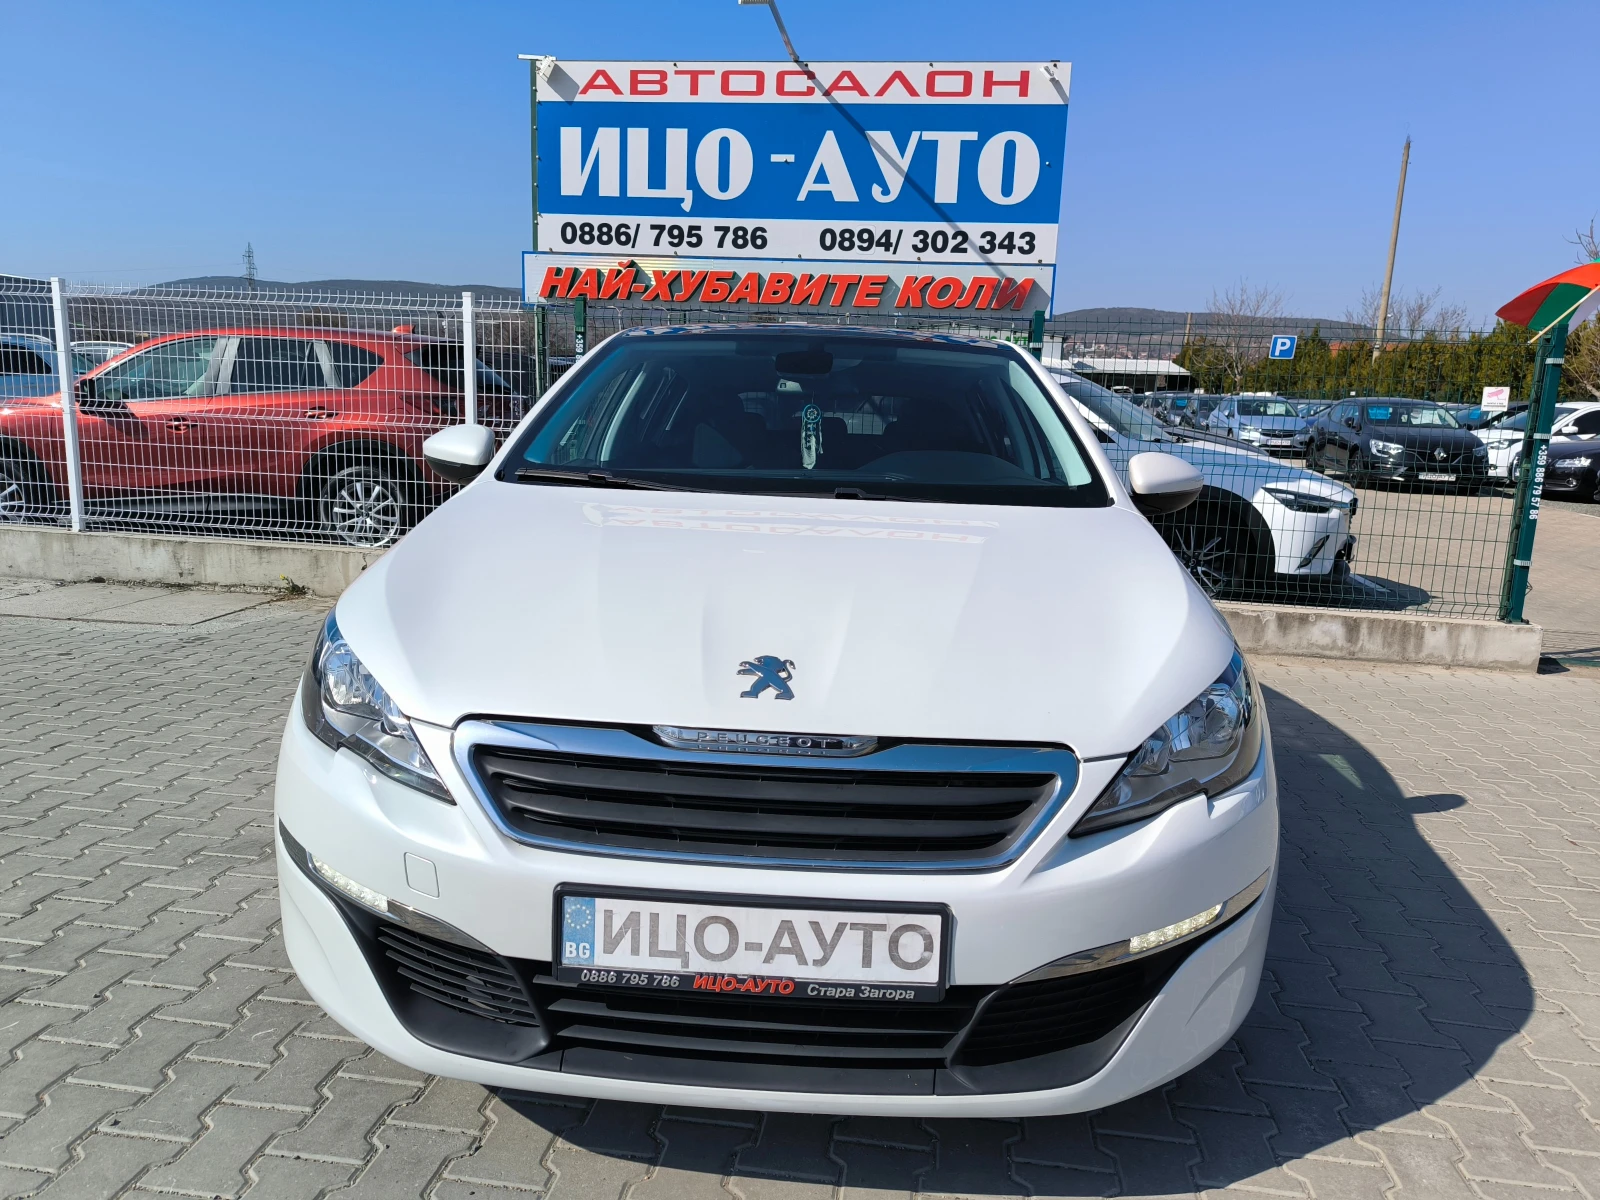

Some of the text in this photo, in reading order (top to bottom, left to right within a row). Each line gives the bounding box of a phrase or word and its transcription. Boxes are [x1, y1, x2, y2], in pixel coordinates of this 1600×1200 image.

[579, 69, 1030, 98] АВТОСАЛОН
[560, 221, 769, 250] 0886/ 795 786
[819, 227, 1036, 255] 0894/ 302 343
[894, 275, 1035, 311] КОЛИ
[1274, 338, 1291, 357] P
[1529, 444, 1547, 519] +359 886 79 57 86
[697, 731, 829, 748] PEUGEOT
[565, 941, 590, 959] BG
[602, 908, 935, 971] ИЦО-АУТО
[580, 969, 681, 988] 0886 795 786
[693, 974, 796, 995] ИЦО-АУТО
[807, 984, 915, 1001] Стара Загора
